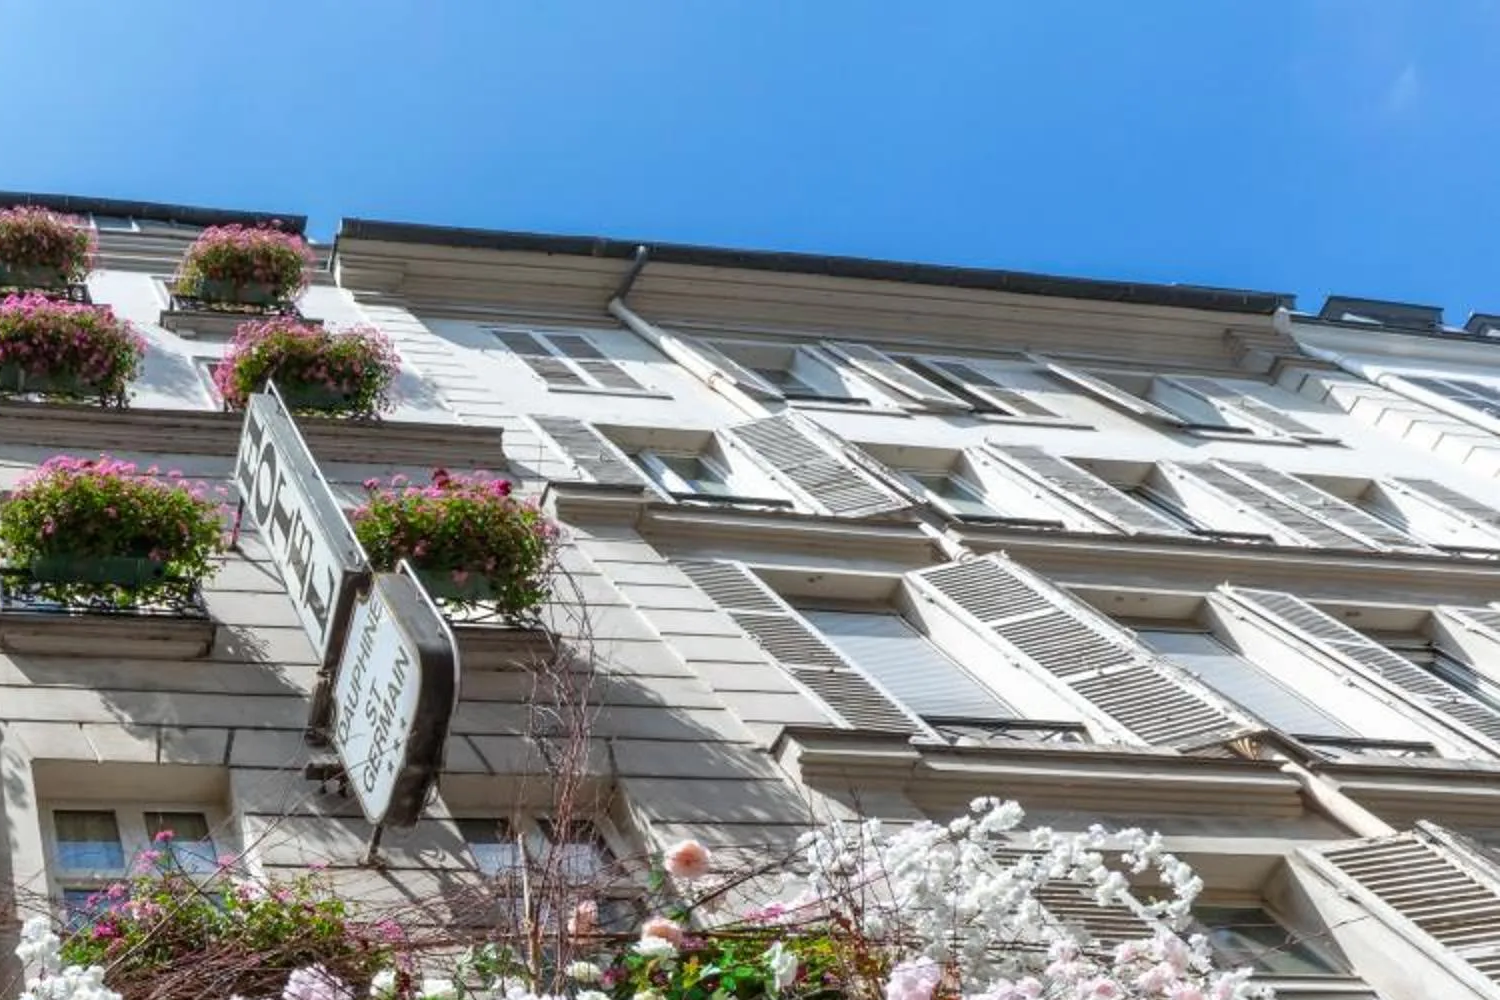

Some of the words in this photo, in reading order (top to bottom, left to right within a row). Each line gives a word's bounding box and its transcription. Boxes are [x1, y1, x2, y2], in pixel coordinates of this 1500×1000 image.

[240, 412, 334, 645] HOTEL
[338, 593, 380, 746] DAUPHINE
[364, 645, 409, 792] GERMAIN
[365, 677, 381, 727] ST
